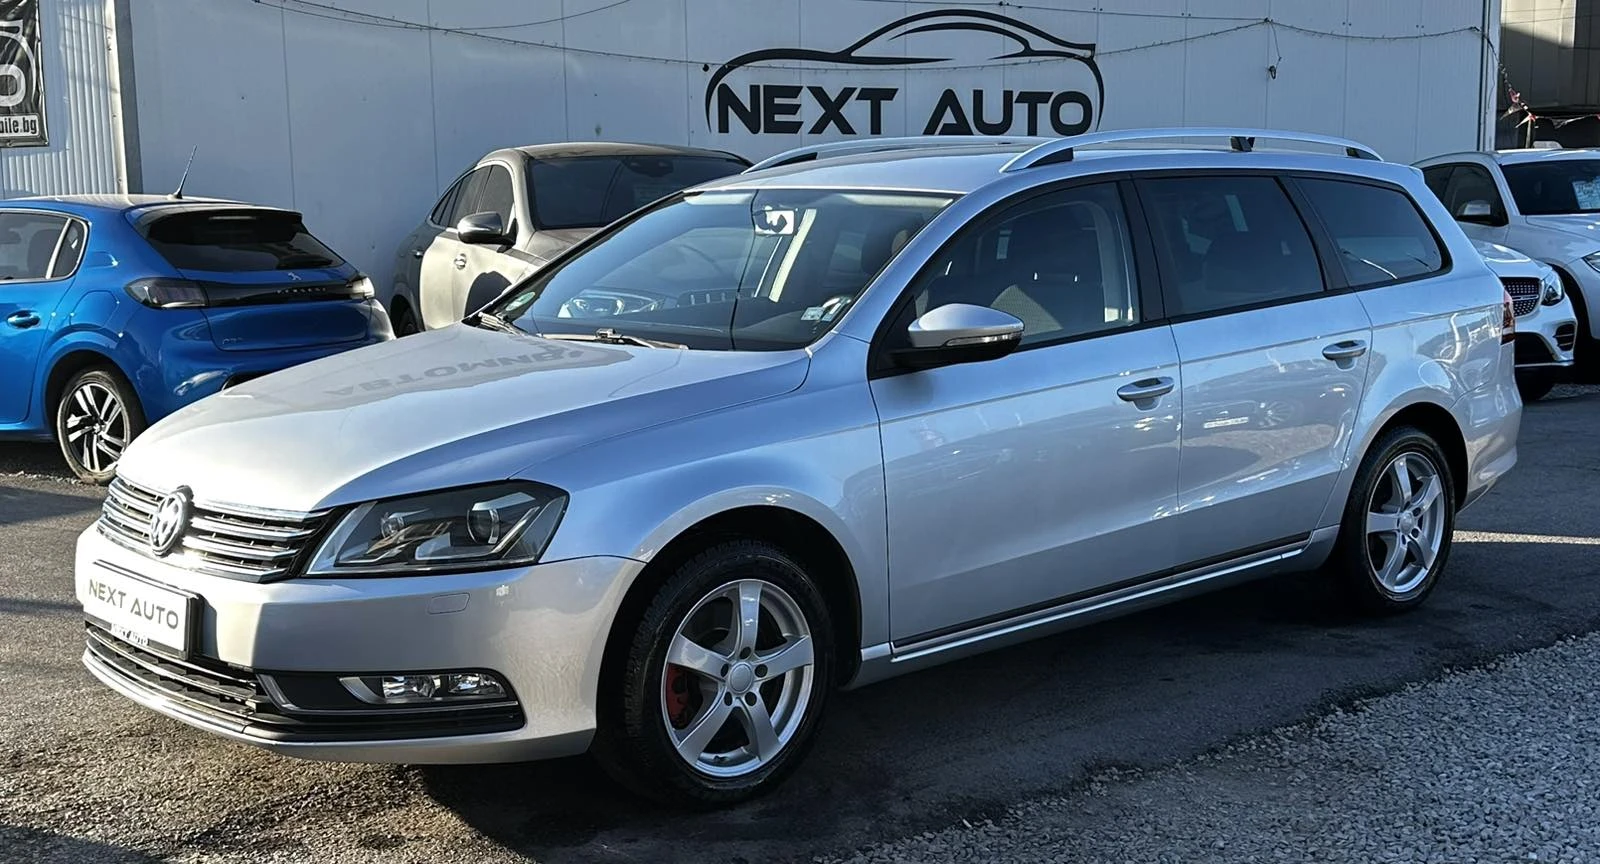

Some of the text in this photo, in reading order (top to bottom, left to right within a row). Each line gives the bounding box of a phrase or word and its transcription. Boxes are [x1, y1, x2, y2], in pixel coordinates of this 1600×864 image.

[717, 83, 1093, 136] NEXT AUTO
[88, 579, 179, 630] NEXT AUTO
